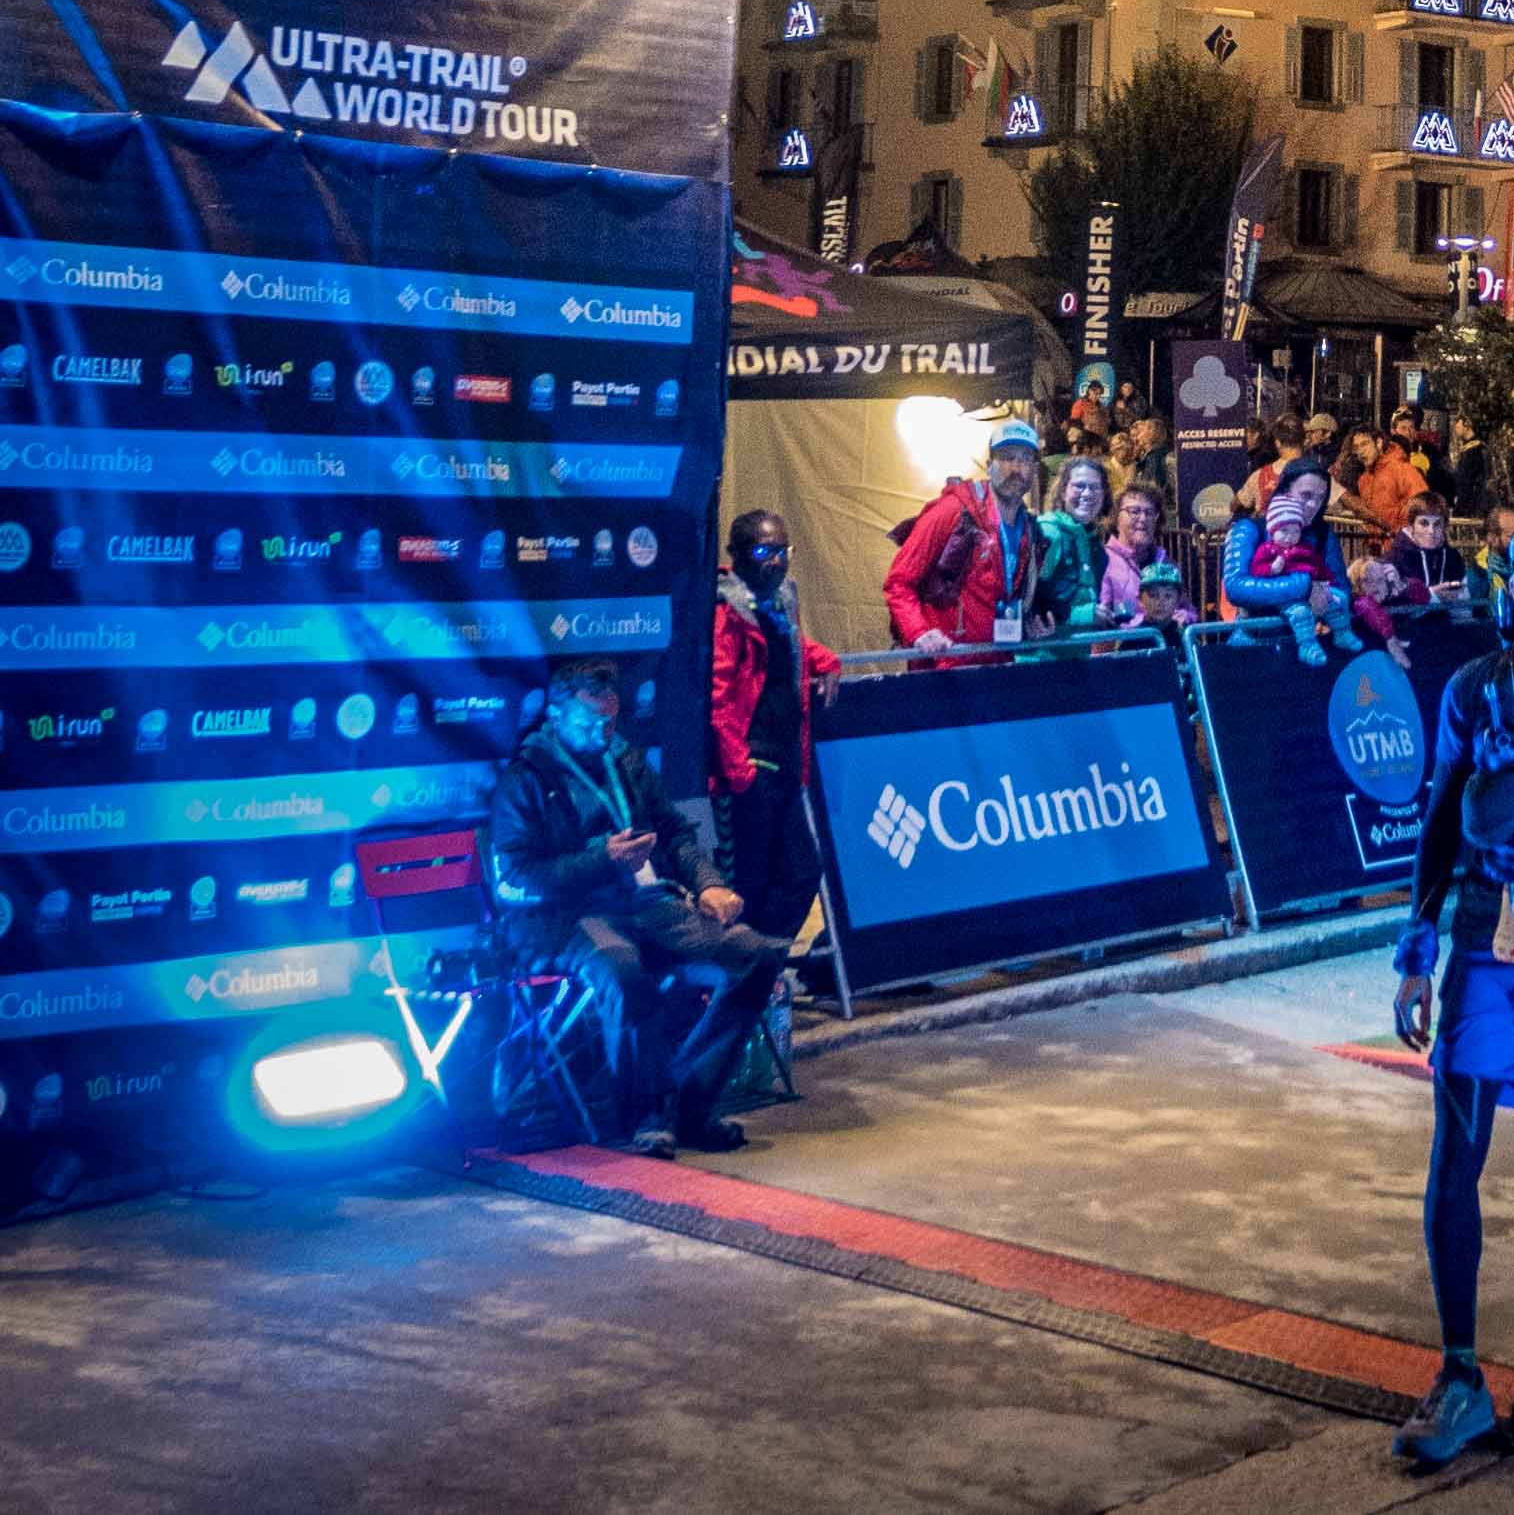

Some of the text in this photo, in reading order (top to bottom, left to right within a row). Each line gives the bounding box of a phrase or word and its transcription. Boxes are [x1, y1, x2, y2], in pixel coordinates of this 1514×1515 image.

[335, 82, 579, 147] WORLD TOUR
[41, 257, 163, 291] Columbia
[245, 273, 351, 305] Columbia
[1084, 215, 1114, 355] FINISHER
[423, 286, 517, 317] Columbia
[582, 298, 682, 328] Columbia
[52, 353, 142, 384] CAMELBAK
[833, 344, 890, 373] DU
[900, 342, 996, 374] TRAIL
[21, 441, 152, 473] Columbia
[240, 447, 346, 477] Columbia
[416, 453, 510, 481] Columbia
[107, 535, 194, 562] CAMELBAK
[11, 622, 136, 651] Columbia
[571, 612, 661, 637] Columbia
[1348, 728, 1415, 764] UTMB
[3, 803, 126, 835] Columbia
[211, 791, 324, 822] Columbia
[927, 761, 1167, 853] Columbia
[209, 963, 318, 998] Columbia
